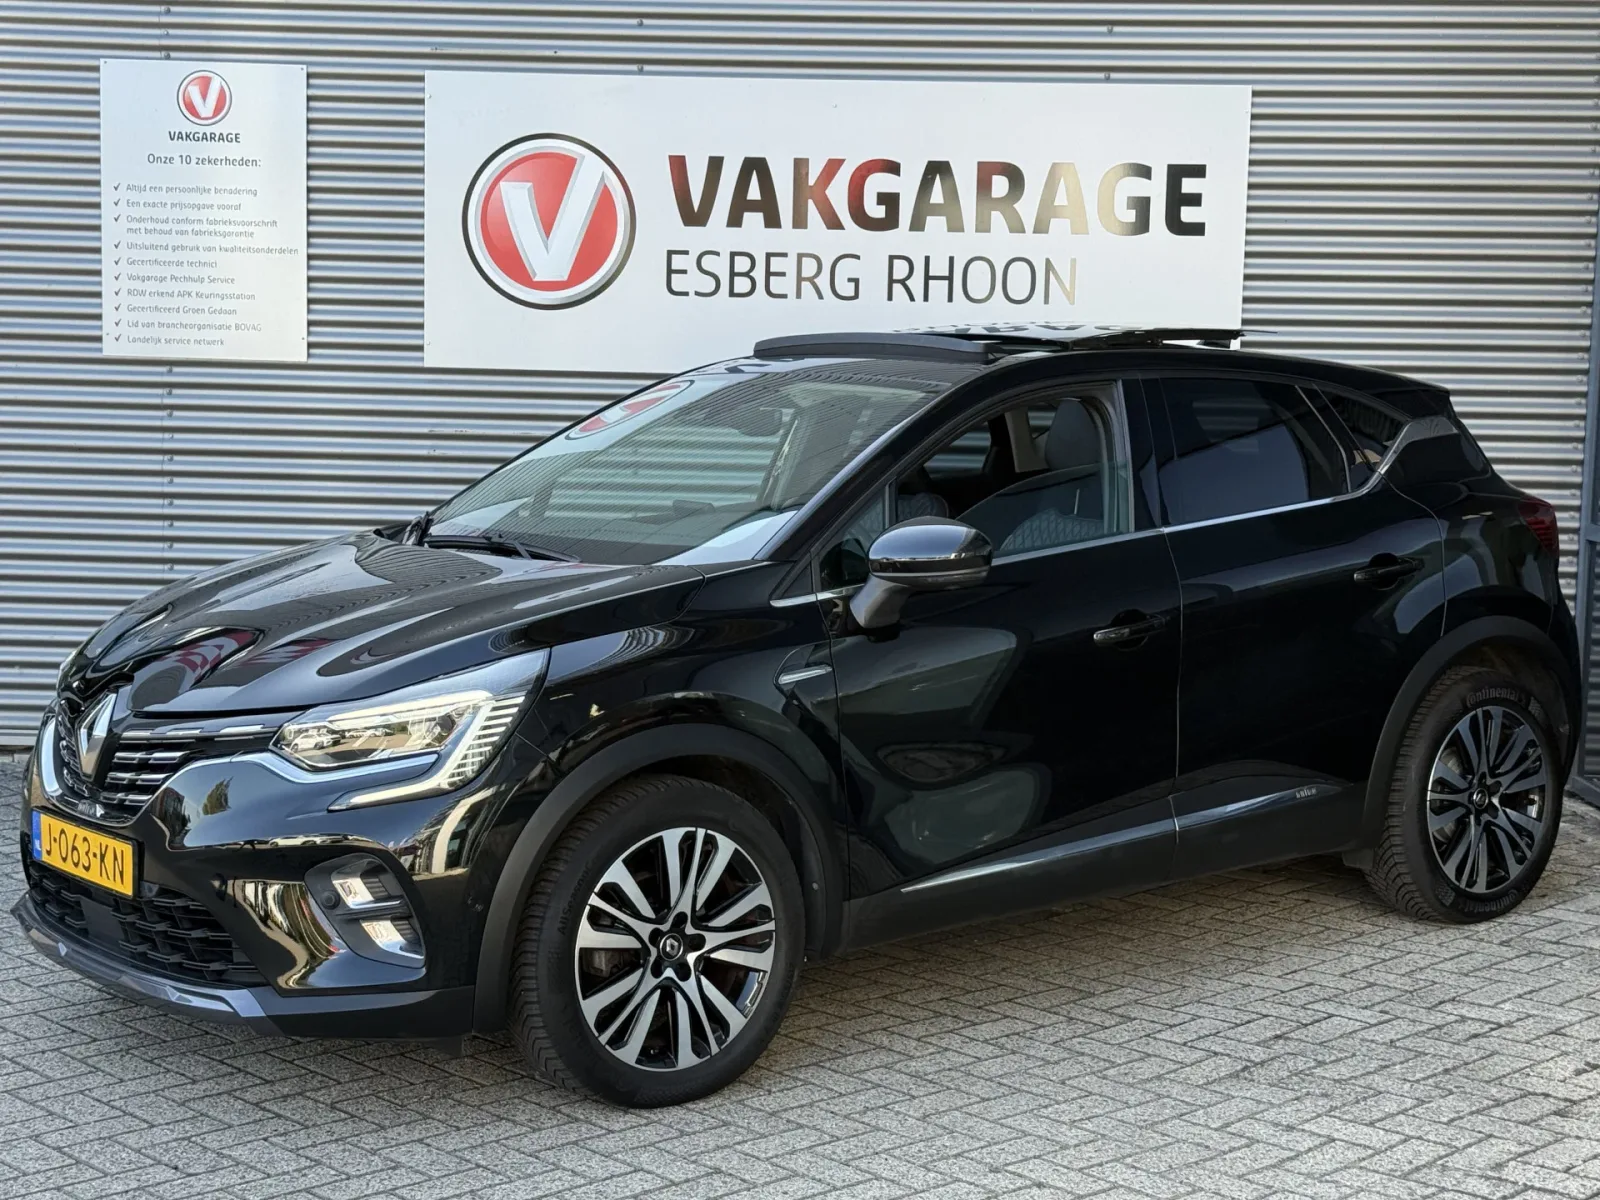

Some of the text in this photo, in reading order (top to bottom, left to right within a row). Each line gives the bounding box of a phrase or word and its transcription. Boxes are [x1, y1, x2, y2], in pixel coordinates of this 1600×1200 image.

[168, 131, 241, 143] VAKGARAGE
[147, 153, 261, 167] Onze 10 zekerheden:
[126, 184, 147, 193] Altijd
[165, 185, 212, 195] persoonlijke
[214, 187, 258, 197] benadering
[668, 155, 1207, 237] VAKGARAGE
[127, 199, 141, 208] Een
[170, 201, 214, 211] prijsopgave
[217, 202, 241, 210] vooraf
[127, 215, 278, 228] Onderhoud conform fabrieksvoorschrift
[144, 227, 172, 236] behoud
[191, 228, 254, 239] fabrieksgarantie
[127, 242, 169, 251] Uitsluitend
[171, 243, 200, 253] gebruik
[219, 245, 299, 255] kwaliteitsonderdelen
[127, 258, 217, 268] Gecertificeerde technici
[127, 273, 235, 285] Vakgarage Pechhulp Service
[665, 249, 1077, 306] ESBERG RHOON
[127, 289, 255, 301] RDW erkend APK Keuringsstation
[127, 304, 237, 315] Gecertificeerd Groen Gedaan
[127, 320, 139, 328] Lid
[157, 321, 232, 331] brancheorganisatie
[234, 322, 262, 331] BOVAG
[127, 335, 225, 346] Landelijk service netwerk
[1466, 685, 1519, 708] Continental
[45, 823, 125, 886] J-063-KN
